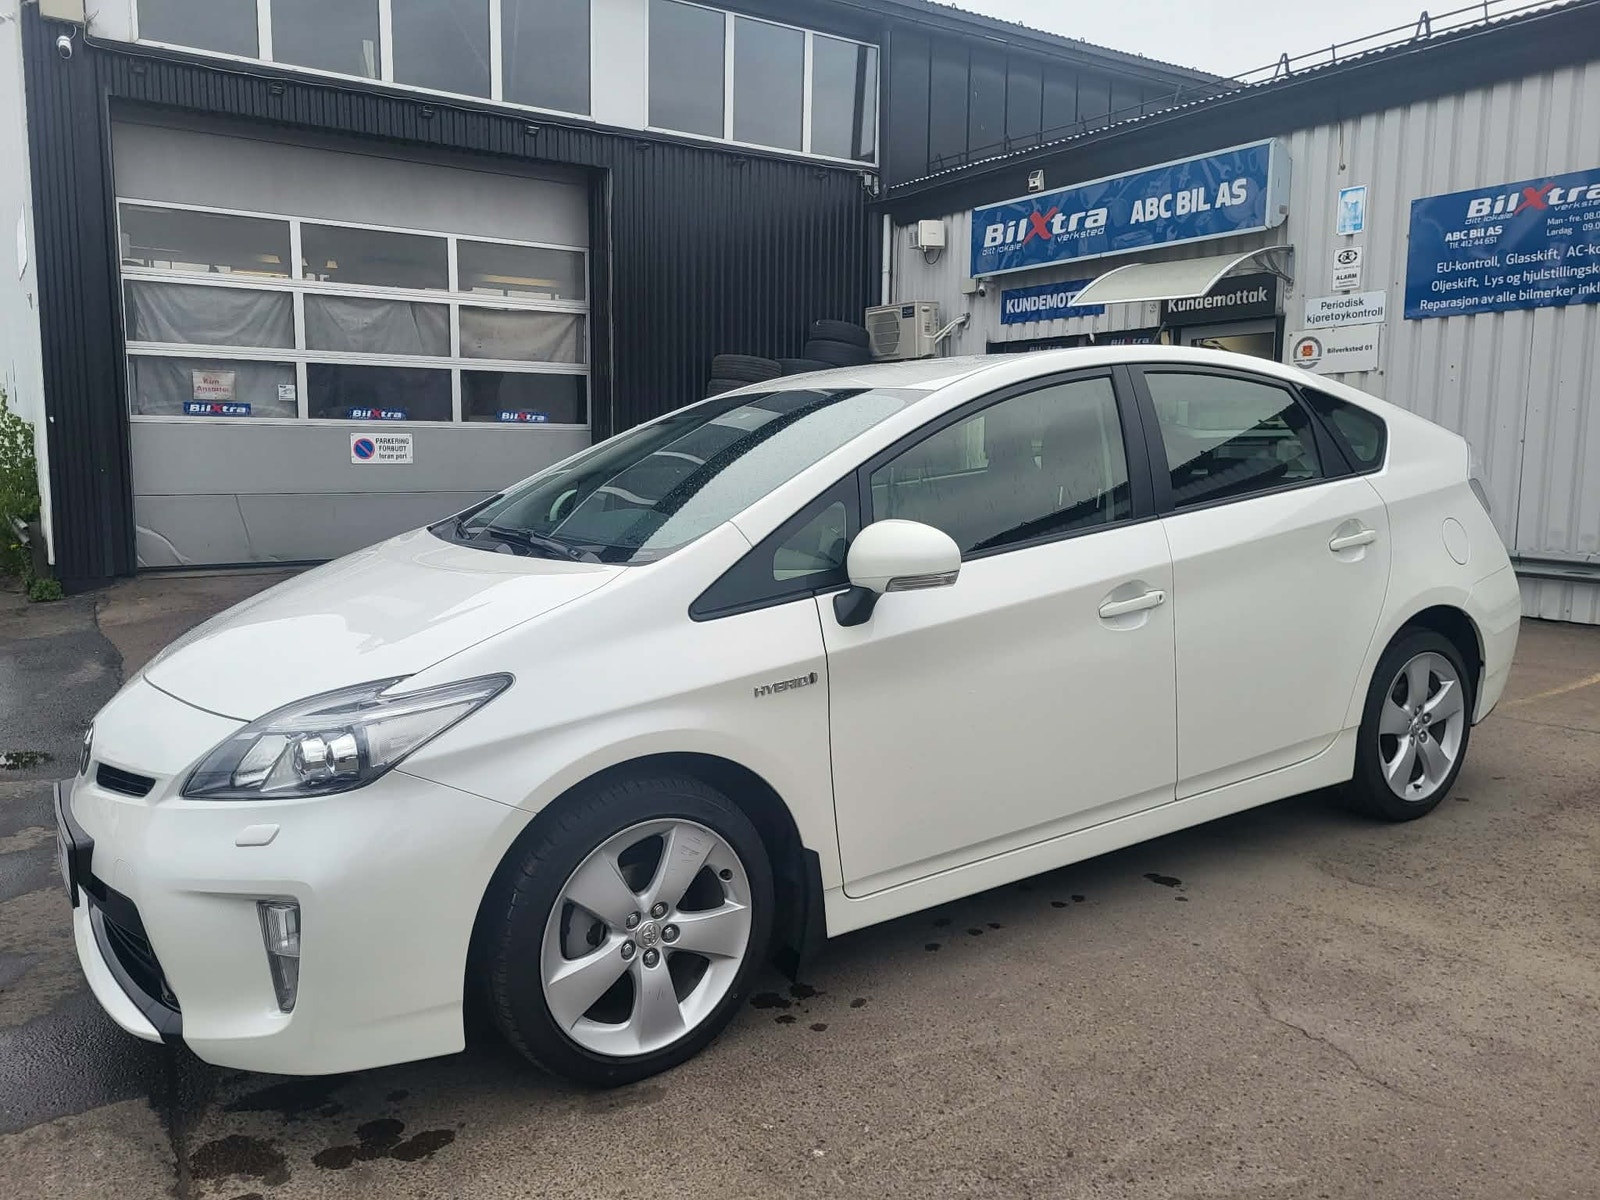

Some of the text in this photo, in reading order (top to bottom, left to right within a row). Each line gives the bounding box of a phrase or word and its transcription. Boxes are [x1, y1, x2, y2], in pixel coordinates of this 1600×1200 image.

[1130, 178, 1247, 225] ABC BIL AS
[983, 206, 1108, 248] BilXtra
[1547, 217, 1564, 226] Man
[1057, 226, 1105, 243] verksted
[1444, 230, 1468, 243] ABC
[1486, 225, 1503, 236] AS
[1437, 256, 1500, 273] EU-kontroll,
[1506, 248, 1561, 265] Glasskift,
[1335, 272, 1358, 281] ALARM
[1431, 262, 1600, 294] Oljeskift, Lys og hjulstillingsk
[1168, 286, 1268, 313] Kundemottak
[1320, 297, 1365, 311] Periodisk
[1420, 298, 1479, 312] Reparasjon
[1480, 297, 1494, 305] av
[1496, 291, 1517, 303] alle
[1519, 285, 1576, 301] bilmerker
[1306, 306, 1384, 324] kjøretøykontroll
[1327, 345, 1363, 354] Bilverksted
[189, 402, 247, 414] BilXtra
[352, 408, 402, 419] BilXtra
[501, 411, 545, 421] BilXtra
[375, 437, 410, 445] PARKERING
[395, 453, 408, 461] port
